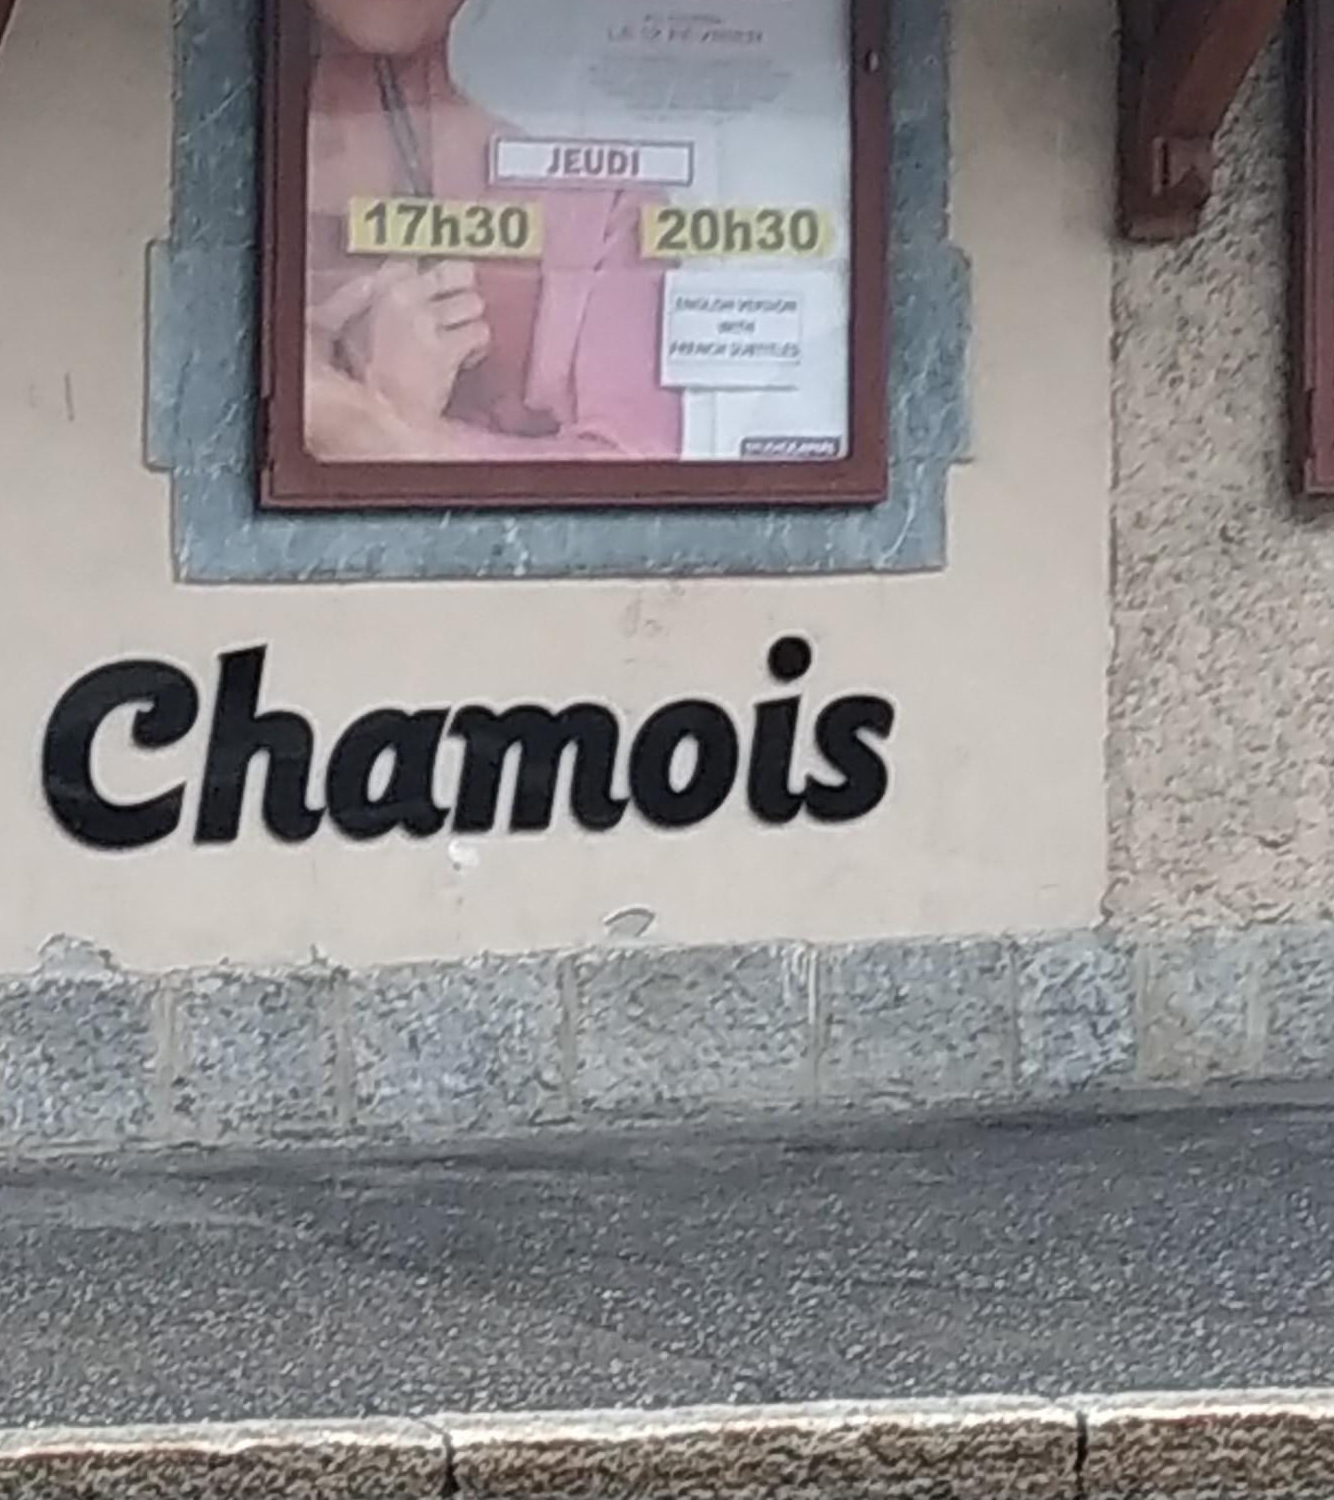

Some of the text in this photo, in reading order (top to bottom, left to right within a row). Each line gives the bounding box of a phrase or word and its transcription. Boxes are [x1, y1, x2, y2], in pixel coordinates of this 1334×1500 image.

[546, 148, 641, 176] JEUDI
[365, 202, 529, 249] 17h30
[655, 208, 820, 252] 20h30
[41, 637, 894, 848] Chamois
